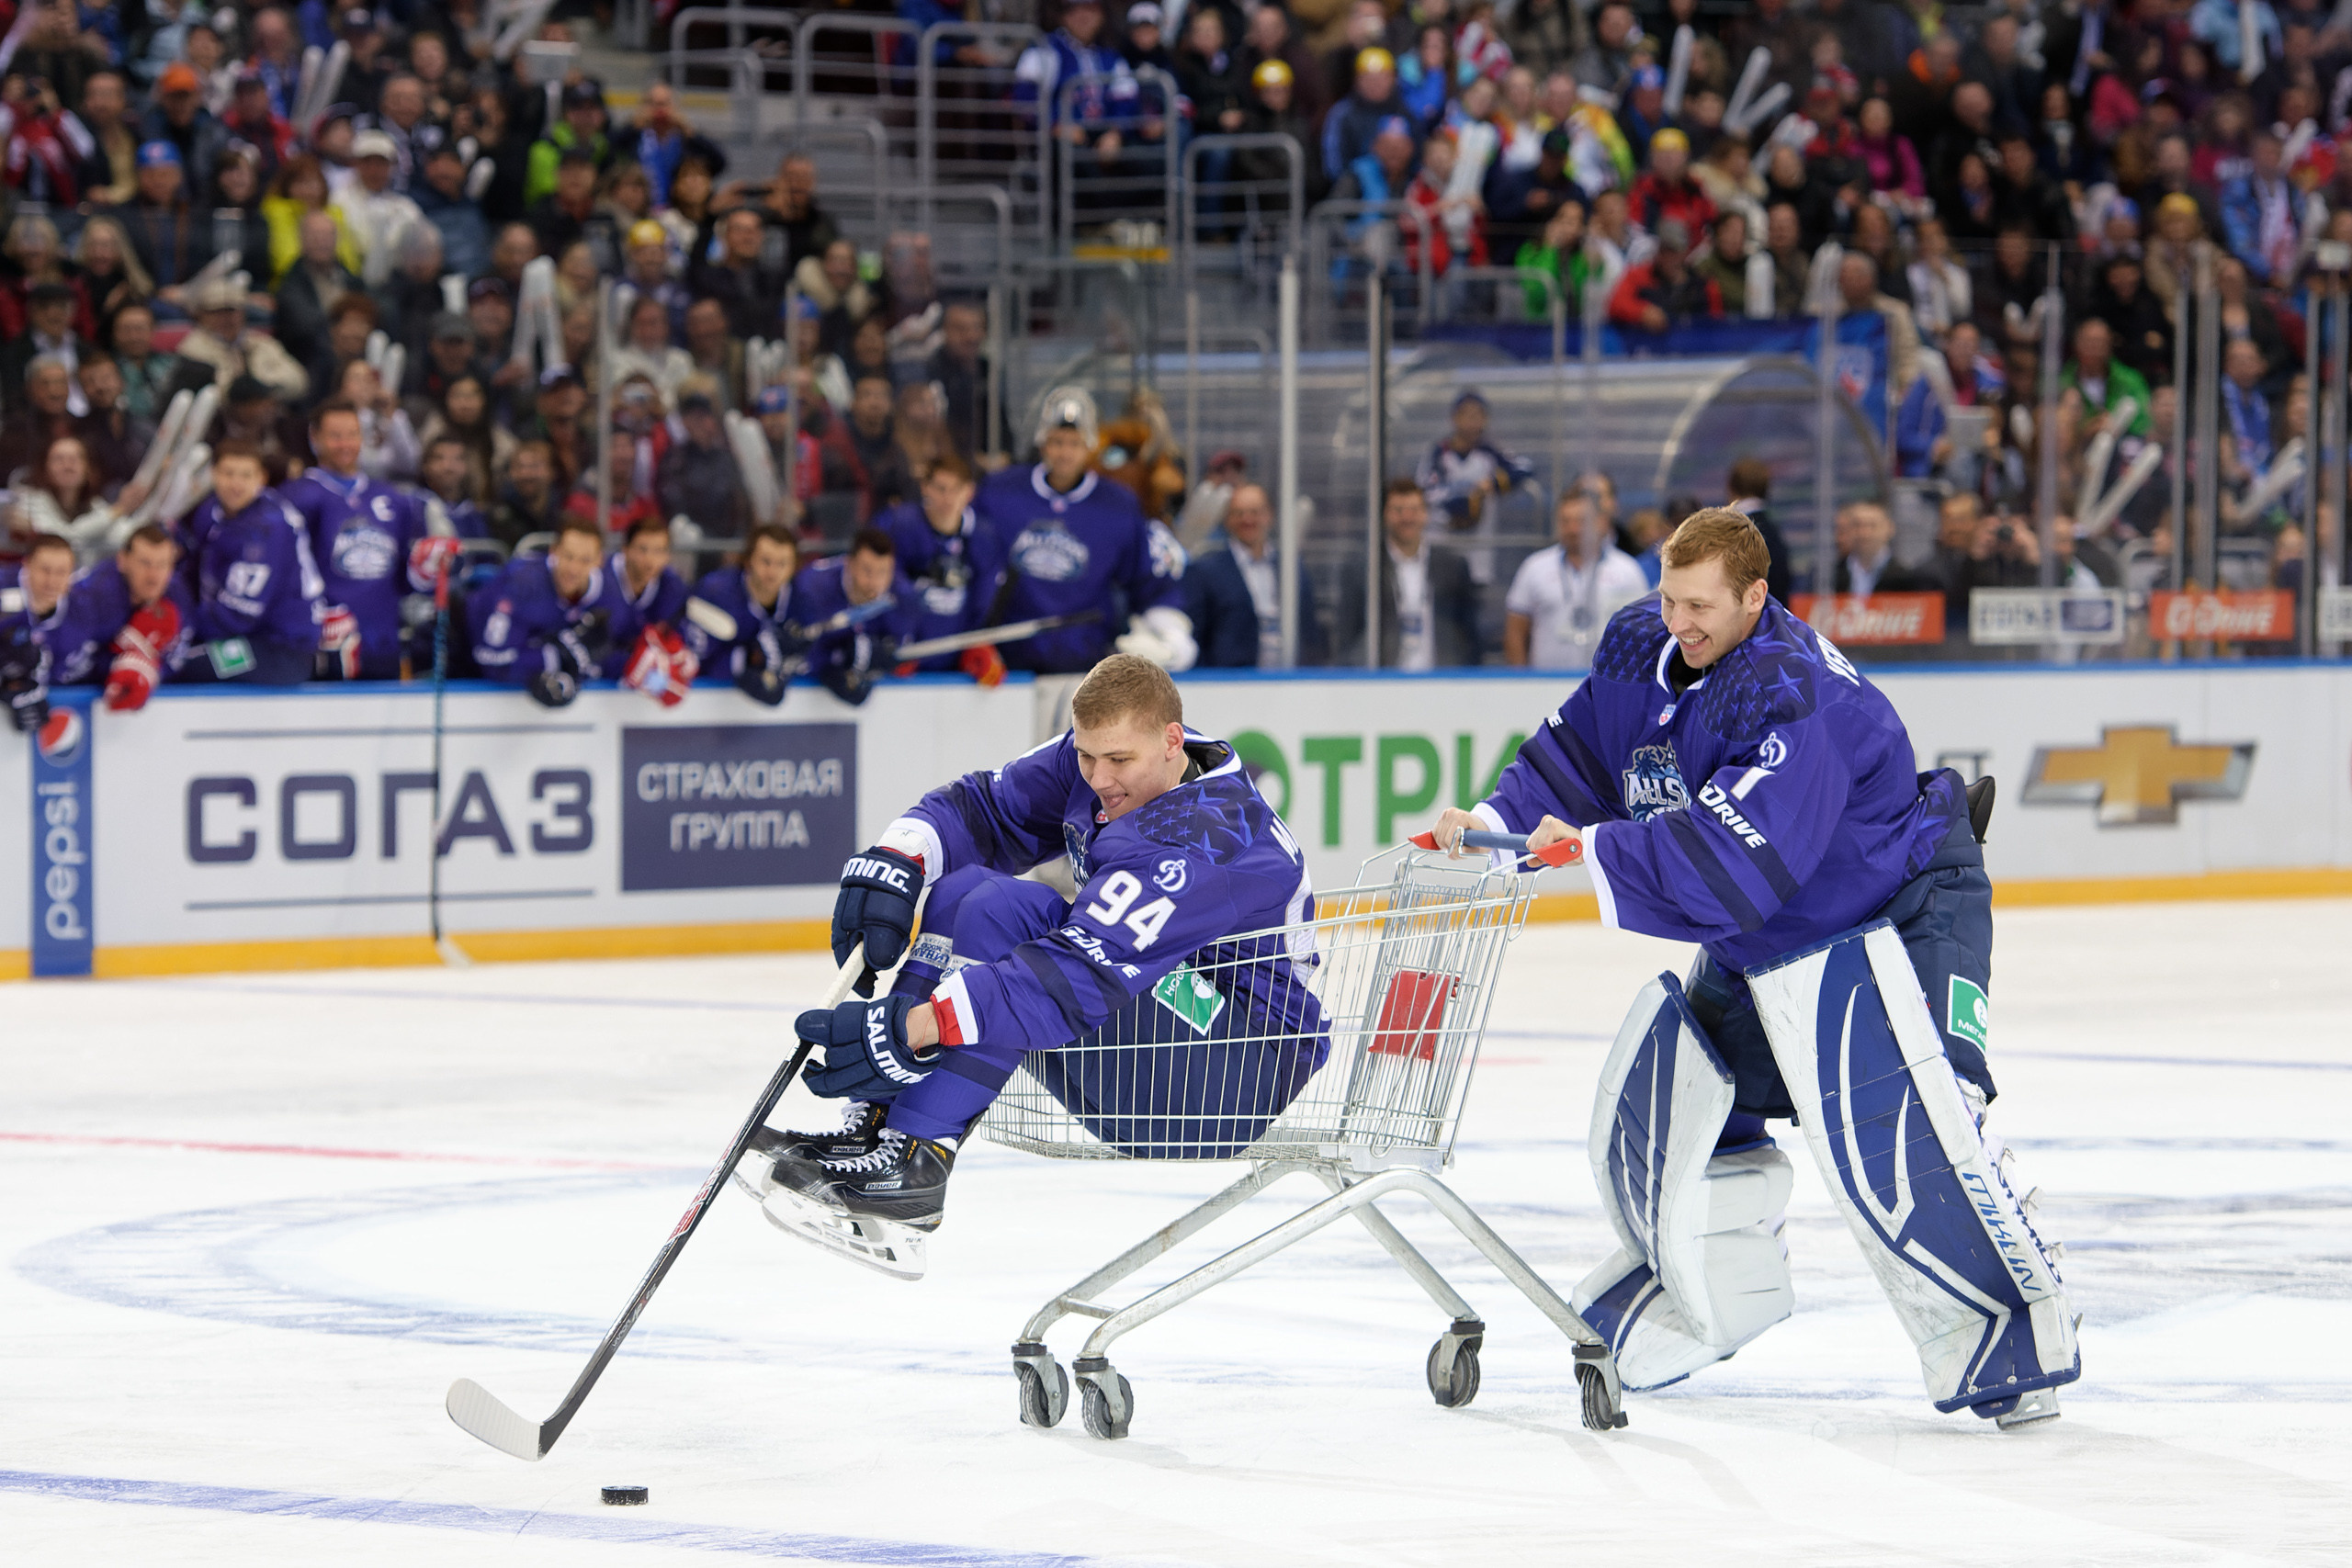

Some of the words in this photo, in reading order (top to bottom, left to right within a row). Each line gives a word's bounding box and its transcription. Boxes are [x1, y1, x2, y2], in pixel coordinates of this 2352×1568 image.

[638, 759, 842, 801] СТРАХОВАЯ
[187, 769, 594, 863] СОГАЗ
[670, 810, 809, 851] ГРУППА
[38, 782, 85, 941] pepsi
[1086, 870, 1177, 953] 94
[866, 1181, 900, 1190] BAUER
